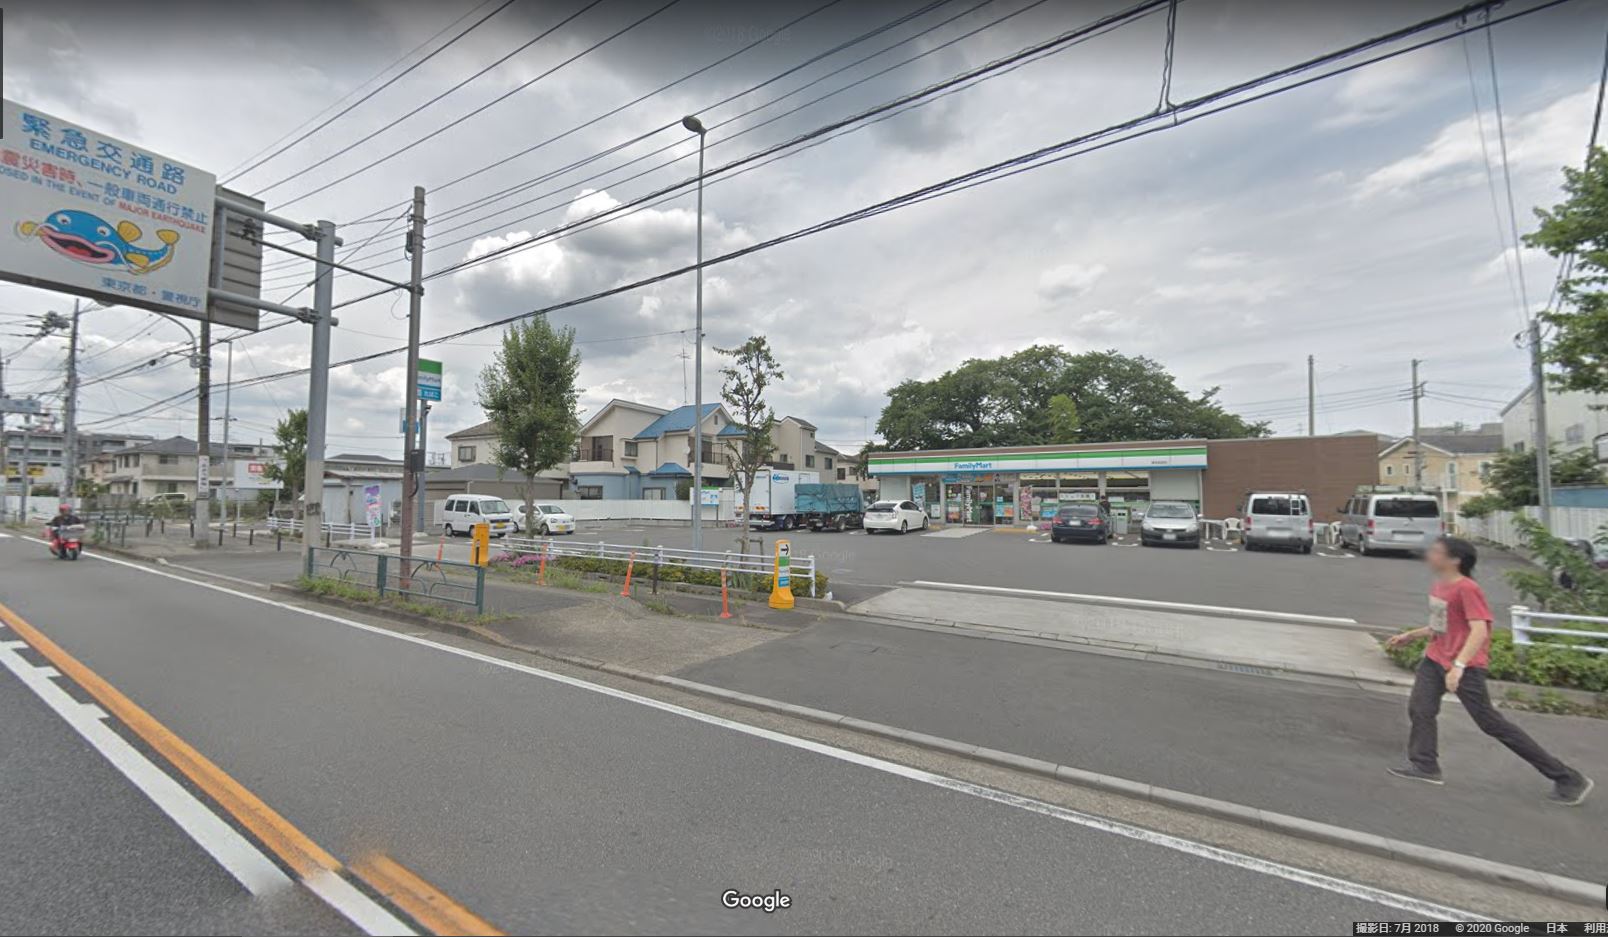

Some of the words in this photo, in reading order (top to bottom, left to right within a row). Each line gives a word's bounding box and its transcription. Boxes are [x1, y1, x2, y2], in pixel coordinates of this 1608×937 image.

[21, 112, 185, 186] 緊急交通路
[30, 138, 131, 180] EMERGENCY
[136, 174, 178, 195] ROAD
[46, 179, 66, 192] THE
[69, 186, 99, 201] EVENT
[103, 196, 116, 206] OF
[119, 201, 150, 217] MAJOR
[151, 211, 206, 234] EARTHQUAKE
[953, 461, 992, 470] FamilyMart
